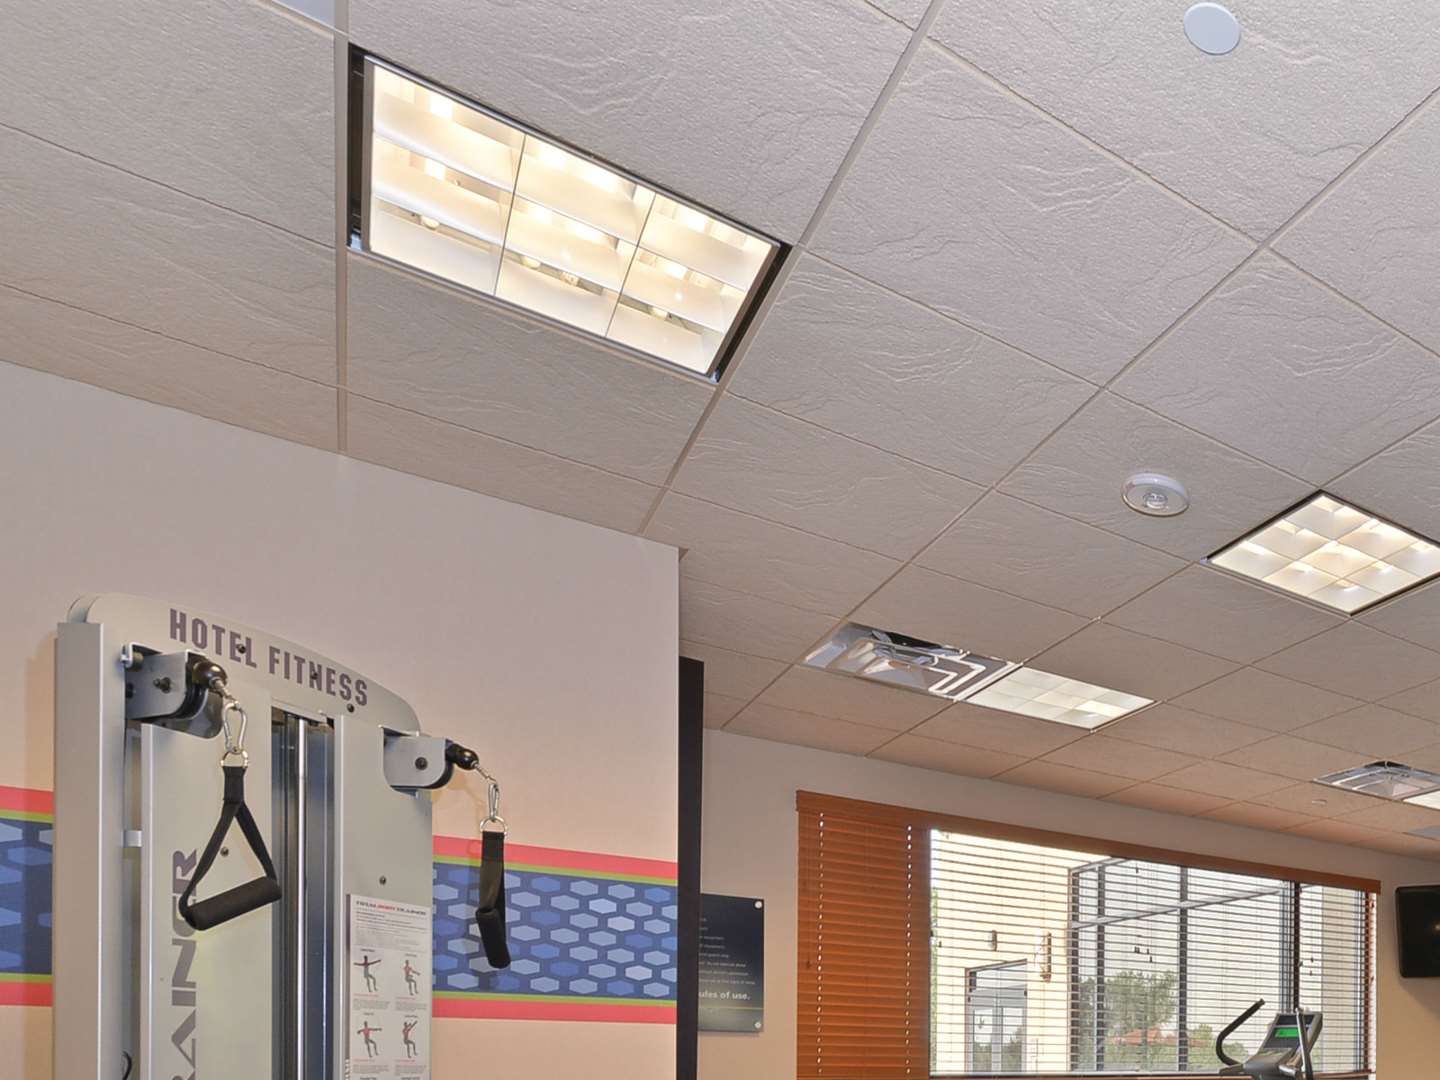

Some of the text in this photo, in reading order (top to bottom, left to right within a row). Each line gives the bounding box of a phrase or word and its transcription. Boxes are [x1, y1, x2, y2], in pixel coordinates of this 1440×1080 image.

[169, 607, 368, 706] HOTEL FITNESS
[719, 990, 730, 1000] of
